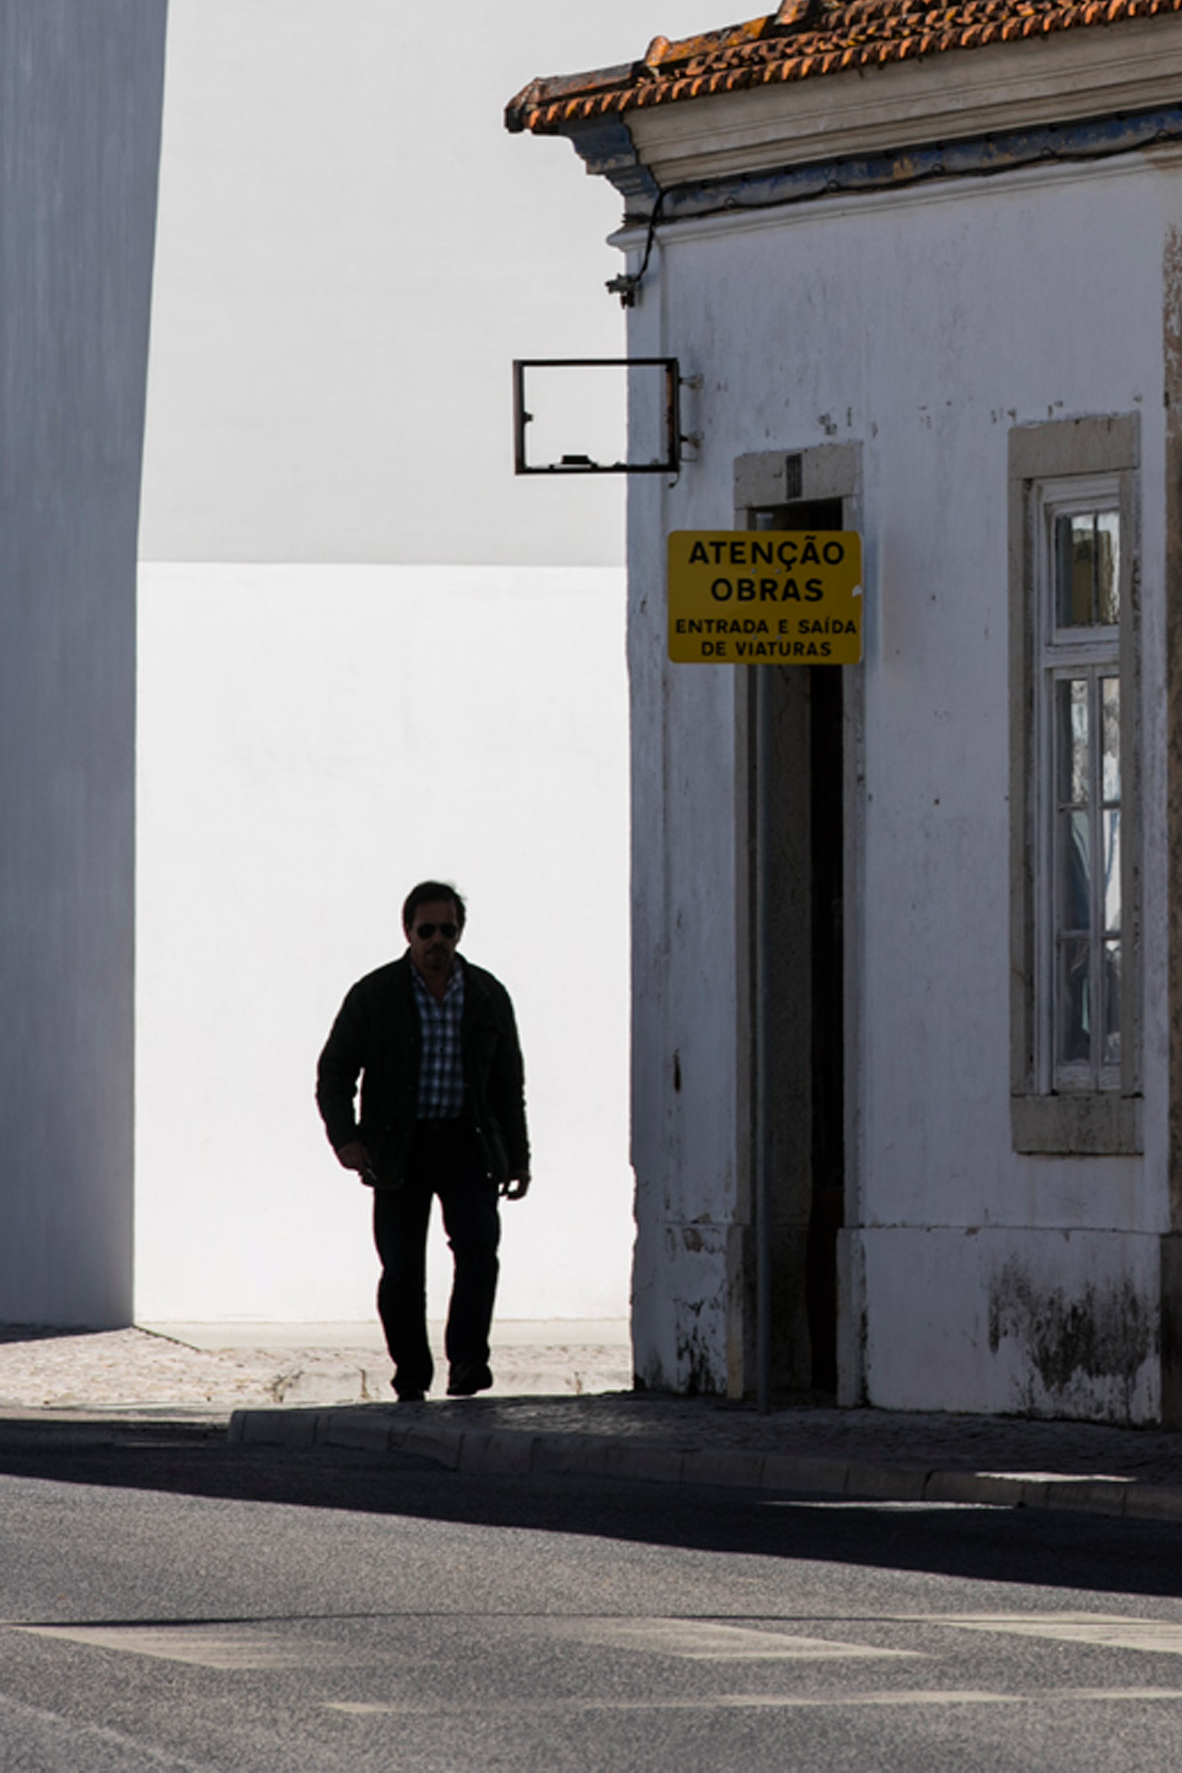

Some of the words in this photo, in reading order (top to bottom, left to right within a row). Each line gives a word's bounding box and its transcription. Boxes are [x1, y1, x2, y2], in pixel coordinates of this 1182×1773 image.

[688, 535, 844, 571] ATENÇÃO
[711, 578, 823, 602] OBRAS
[676, 619, 769, 634] ENTRADA
[778, 619, 788, 634] E
[798, 616, 857, 634] SAÍDA
[701, 642, 726, 656] DE
[736, 642, 832, 656] VIATURAS
